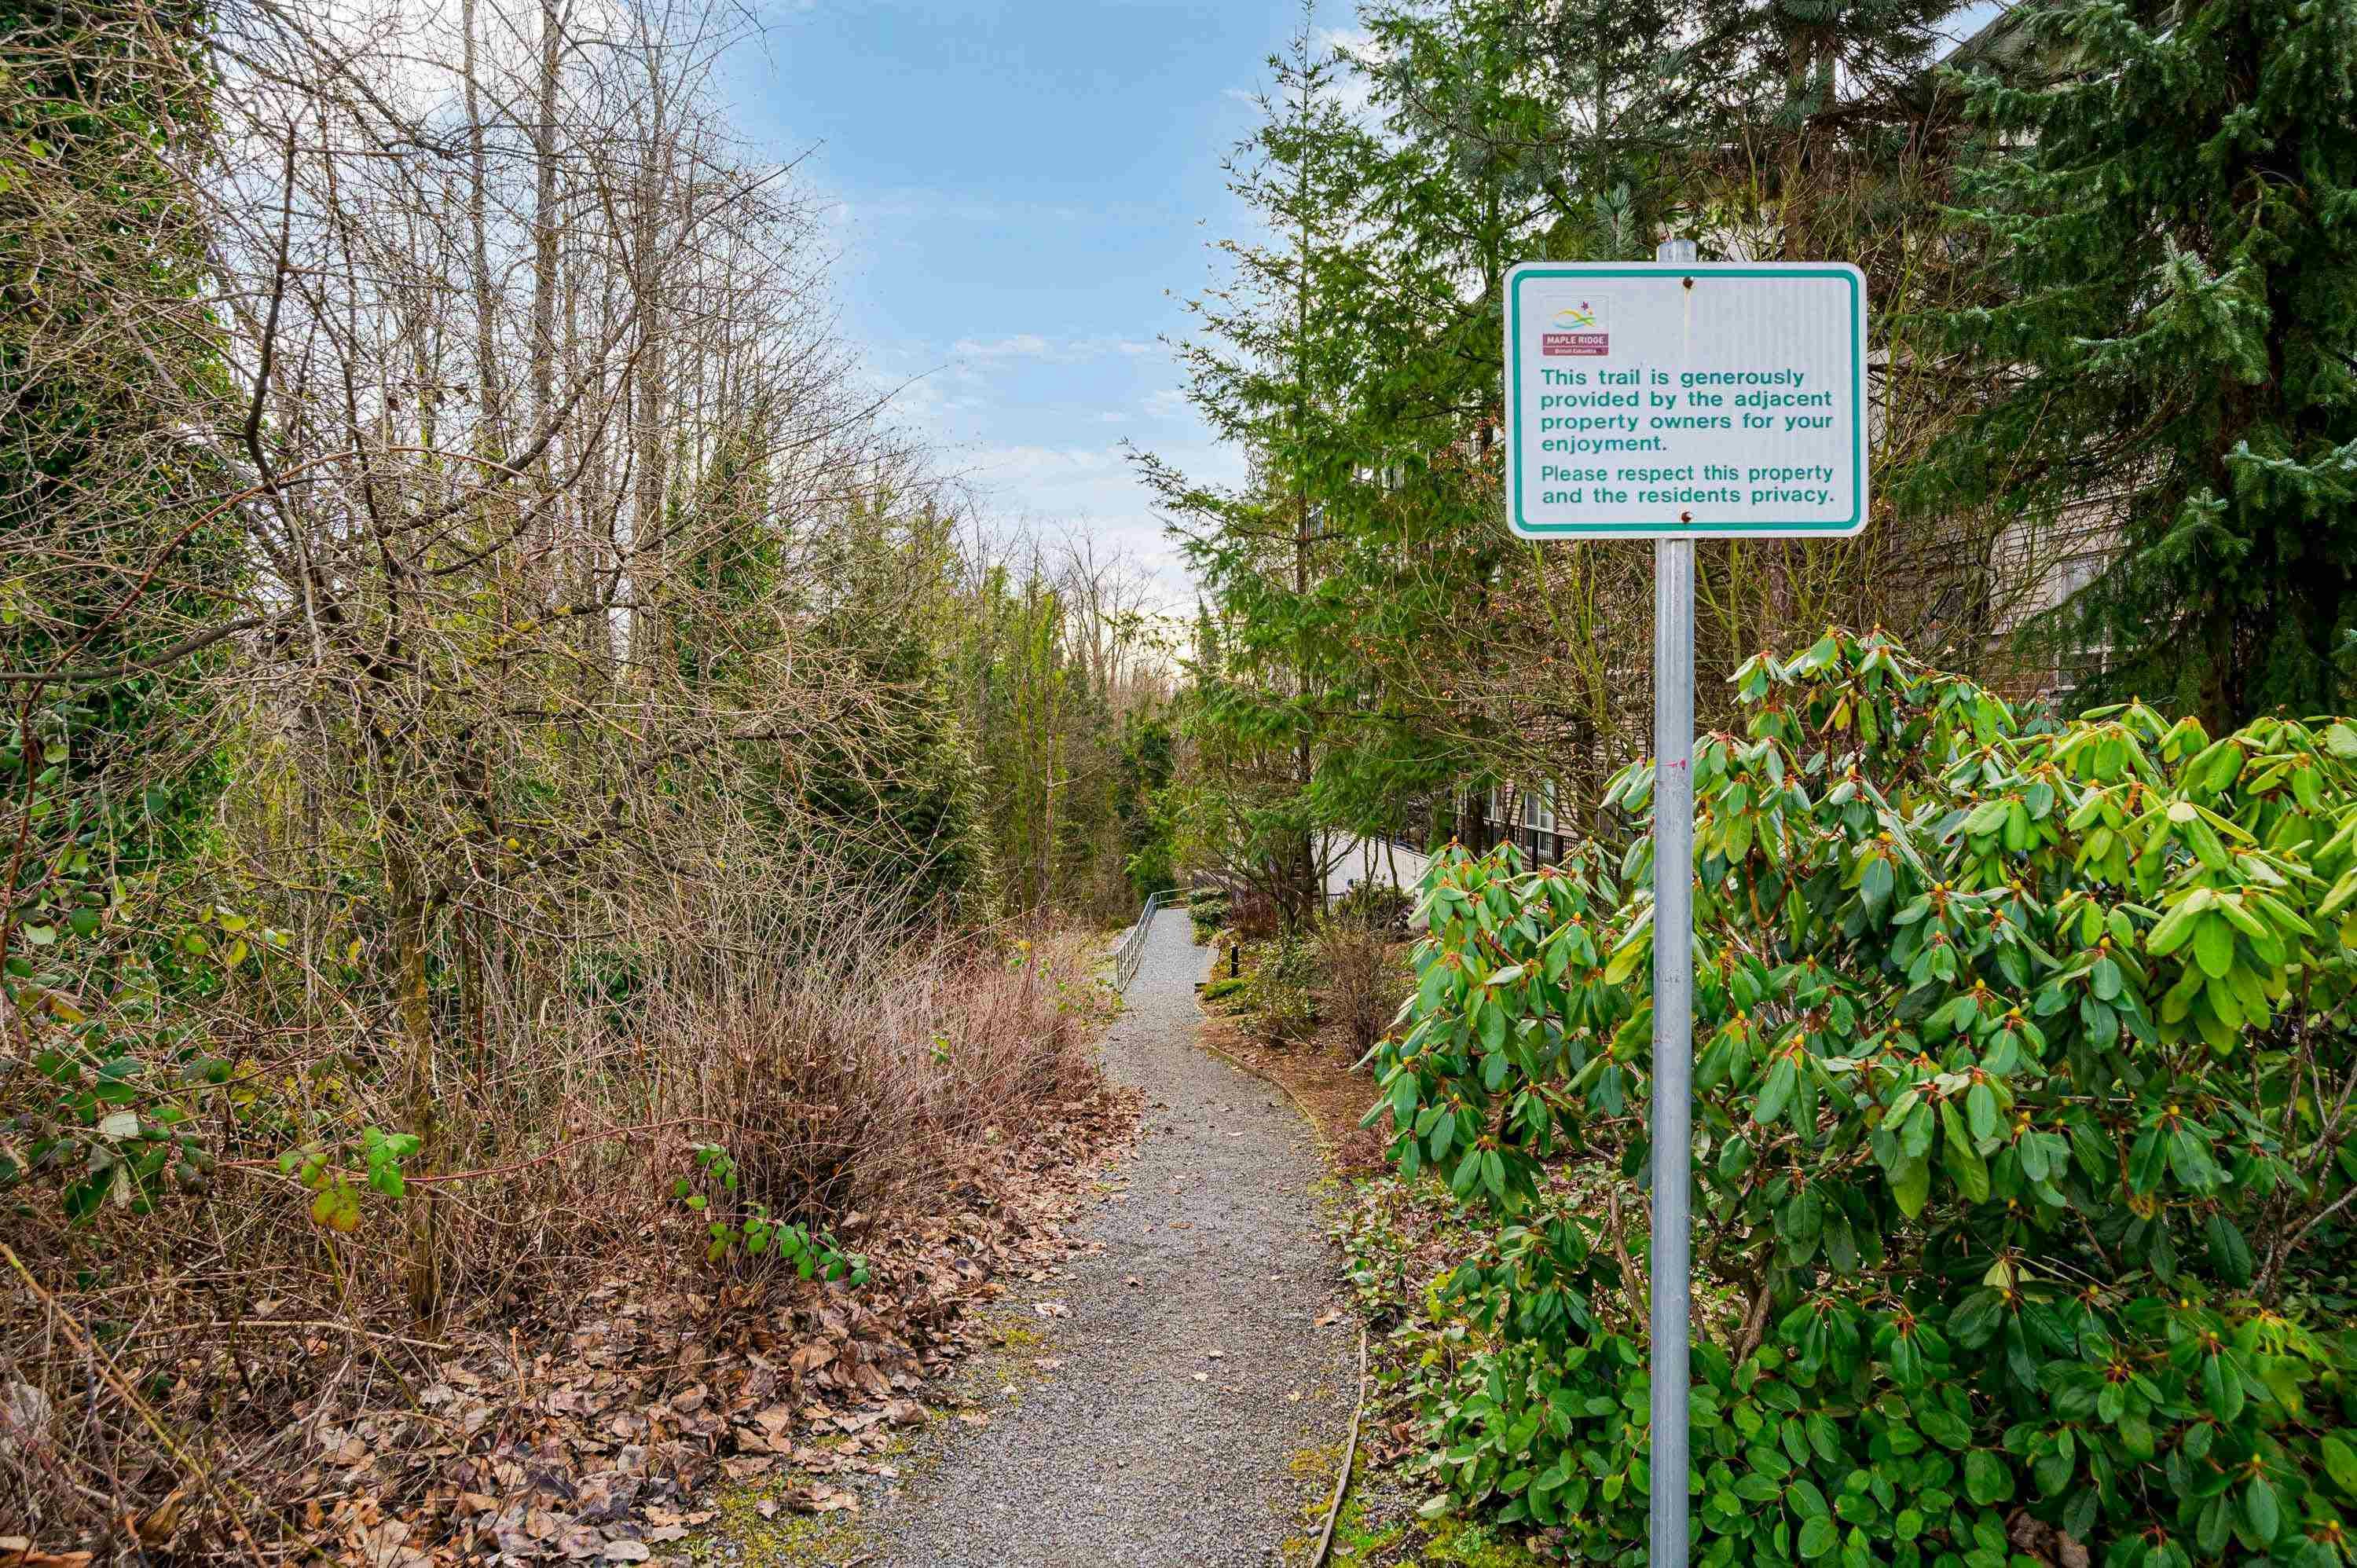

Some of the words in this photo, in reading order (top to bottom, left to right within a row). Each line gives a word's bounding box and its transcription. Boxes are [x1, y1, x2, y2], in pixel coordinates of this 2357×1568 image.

[1546, 335, 1577, 345] MAPLE
[1578, 335, 1604, 345] RIDGE
[1540, 368, 1587, 386] This
[1598, 368, 1640, 385] trail
[1651, 368, 1670, 385] is
[1680, 368, 1805, 389] generously
[1540, 390, 1640, 411] provided
[1650, 390, 1677, 410] by
[1687, 390, 1724, 407] the
[1734, 390, 1832, 410] adjacent
[1541, 414, 1639, 433] property
[1649, 416, 1732, 429] owners
[1742, 412, 1774, 429] for
[1784, 416, 1834, 432] your
[1541, 435, 1667, 455] enjoyment.
[1541, 464, 1608, 482] Please
[1617, 465, 1695, 485] respect
[1703, 464, 1739, 481] this
[1748, 464, 1834, 484] property
[1542, 487, 1582, 504] and
[1593, 487, 1629, 504] the
[1638, 486, 1741, 504] residents
[1751, 485, 1835, 506] privacy.
